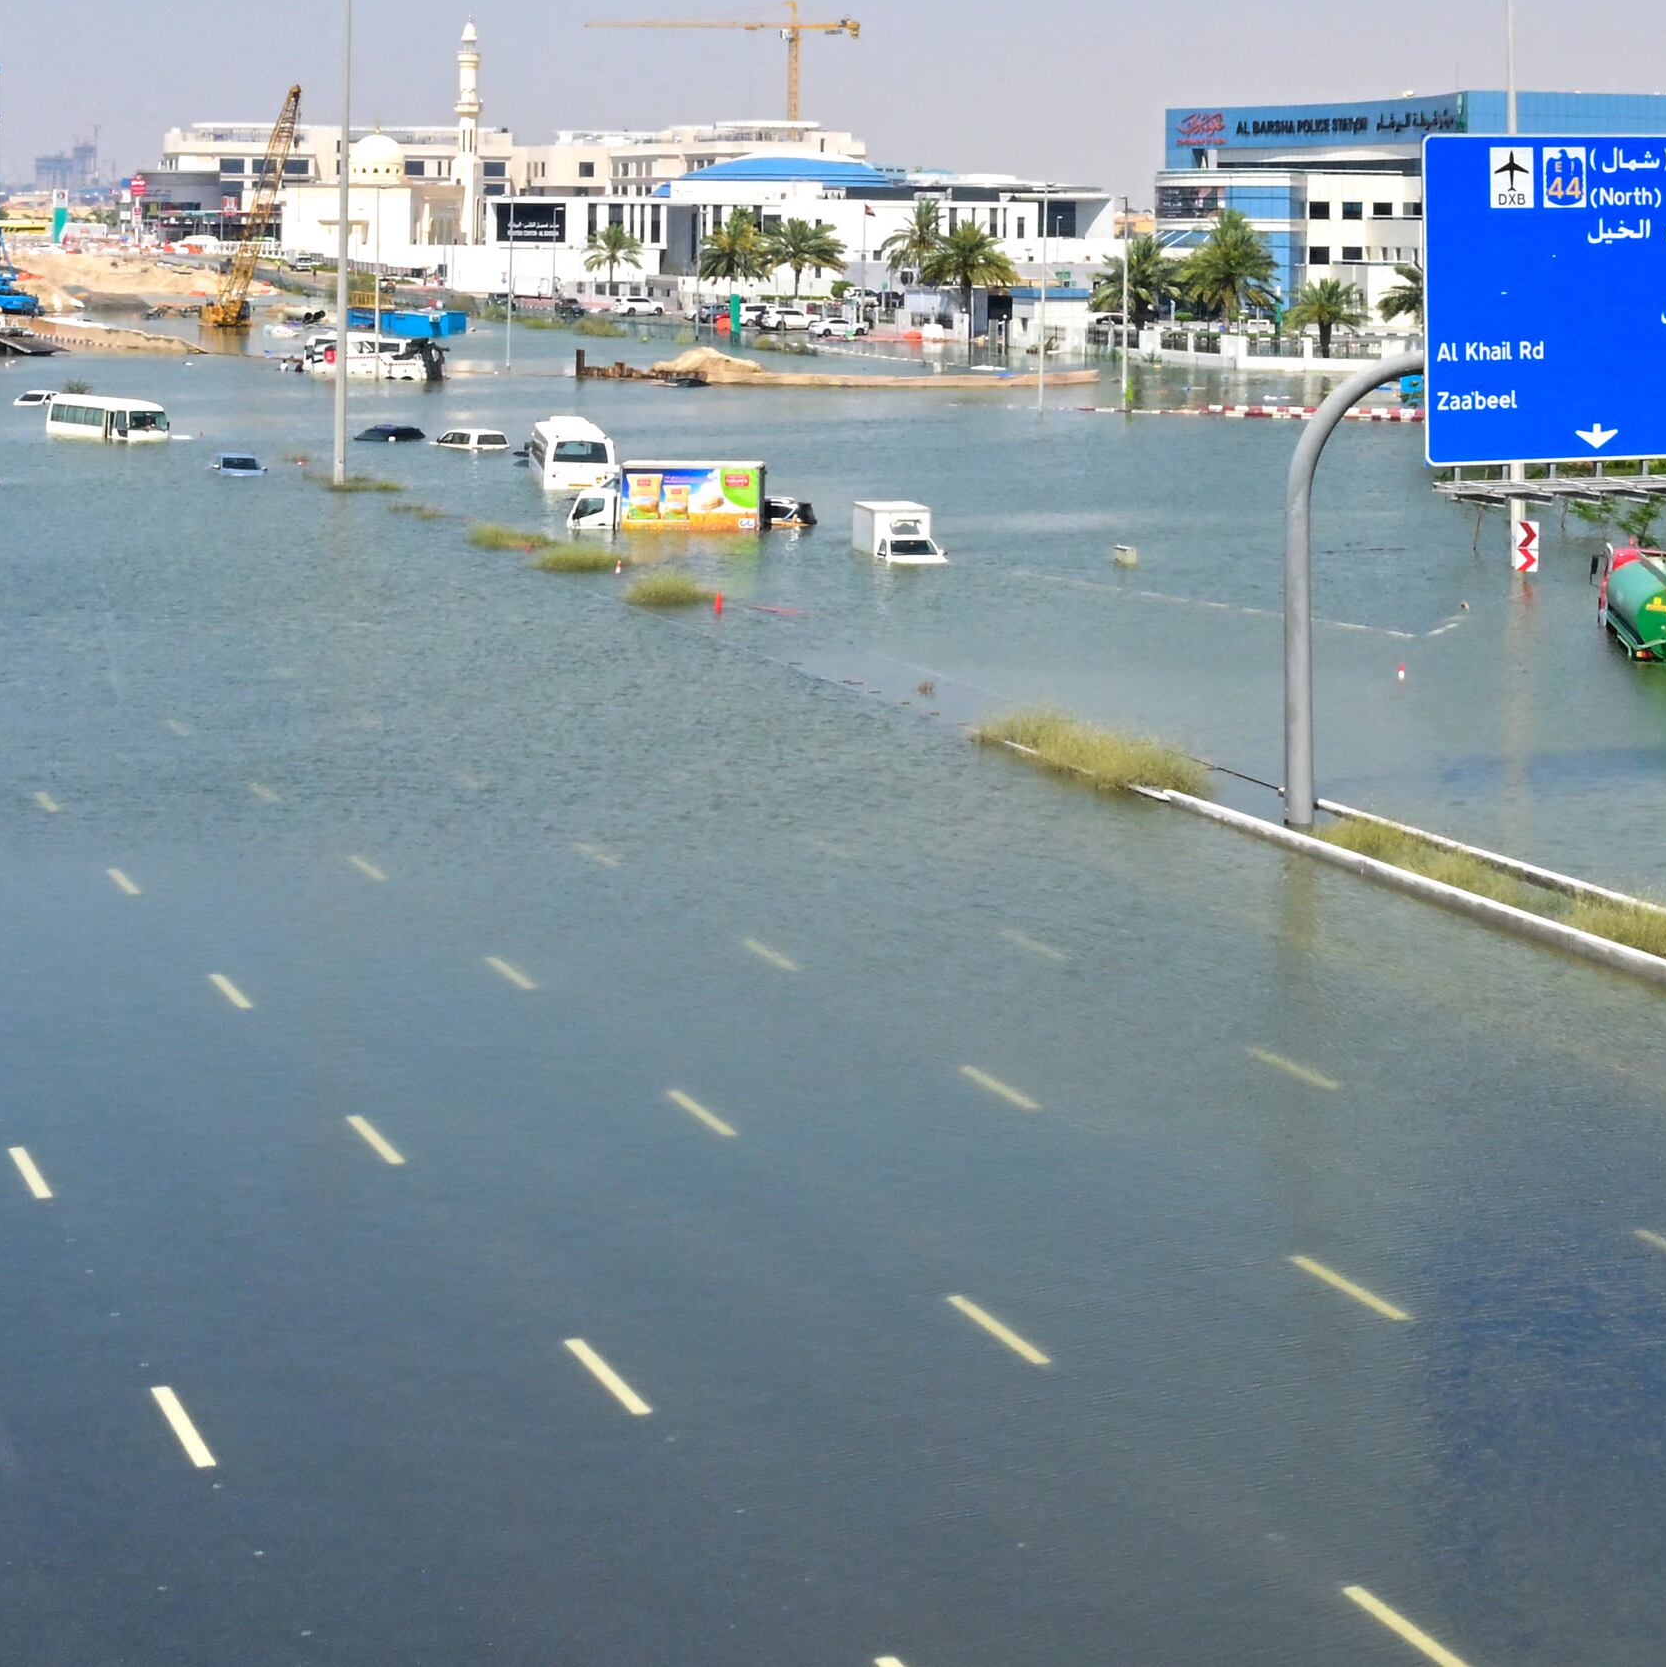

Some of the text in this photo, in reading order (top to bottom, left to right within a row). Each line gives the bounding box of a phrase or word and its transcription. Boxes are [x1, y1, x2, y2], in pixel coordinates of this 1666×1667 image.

[1554, 160, 1563, 173] E
[1547, 176, 1582, 200] 44
[1590, 187, 1662, 209] (North)
[1498, 193, 1526, 206] DXB
[1587, 217, 1651, 245] الخيل
[1436, 340, 1544, 362] Al Khail Rd
[1436, 390, 1518, 411] Zaa'beel
